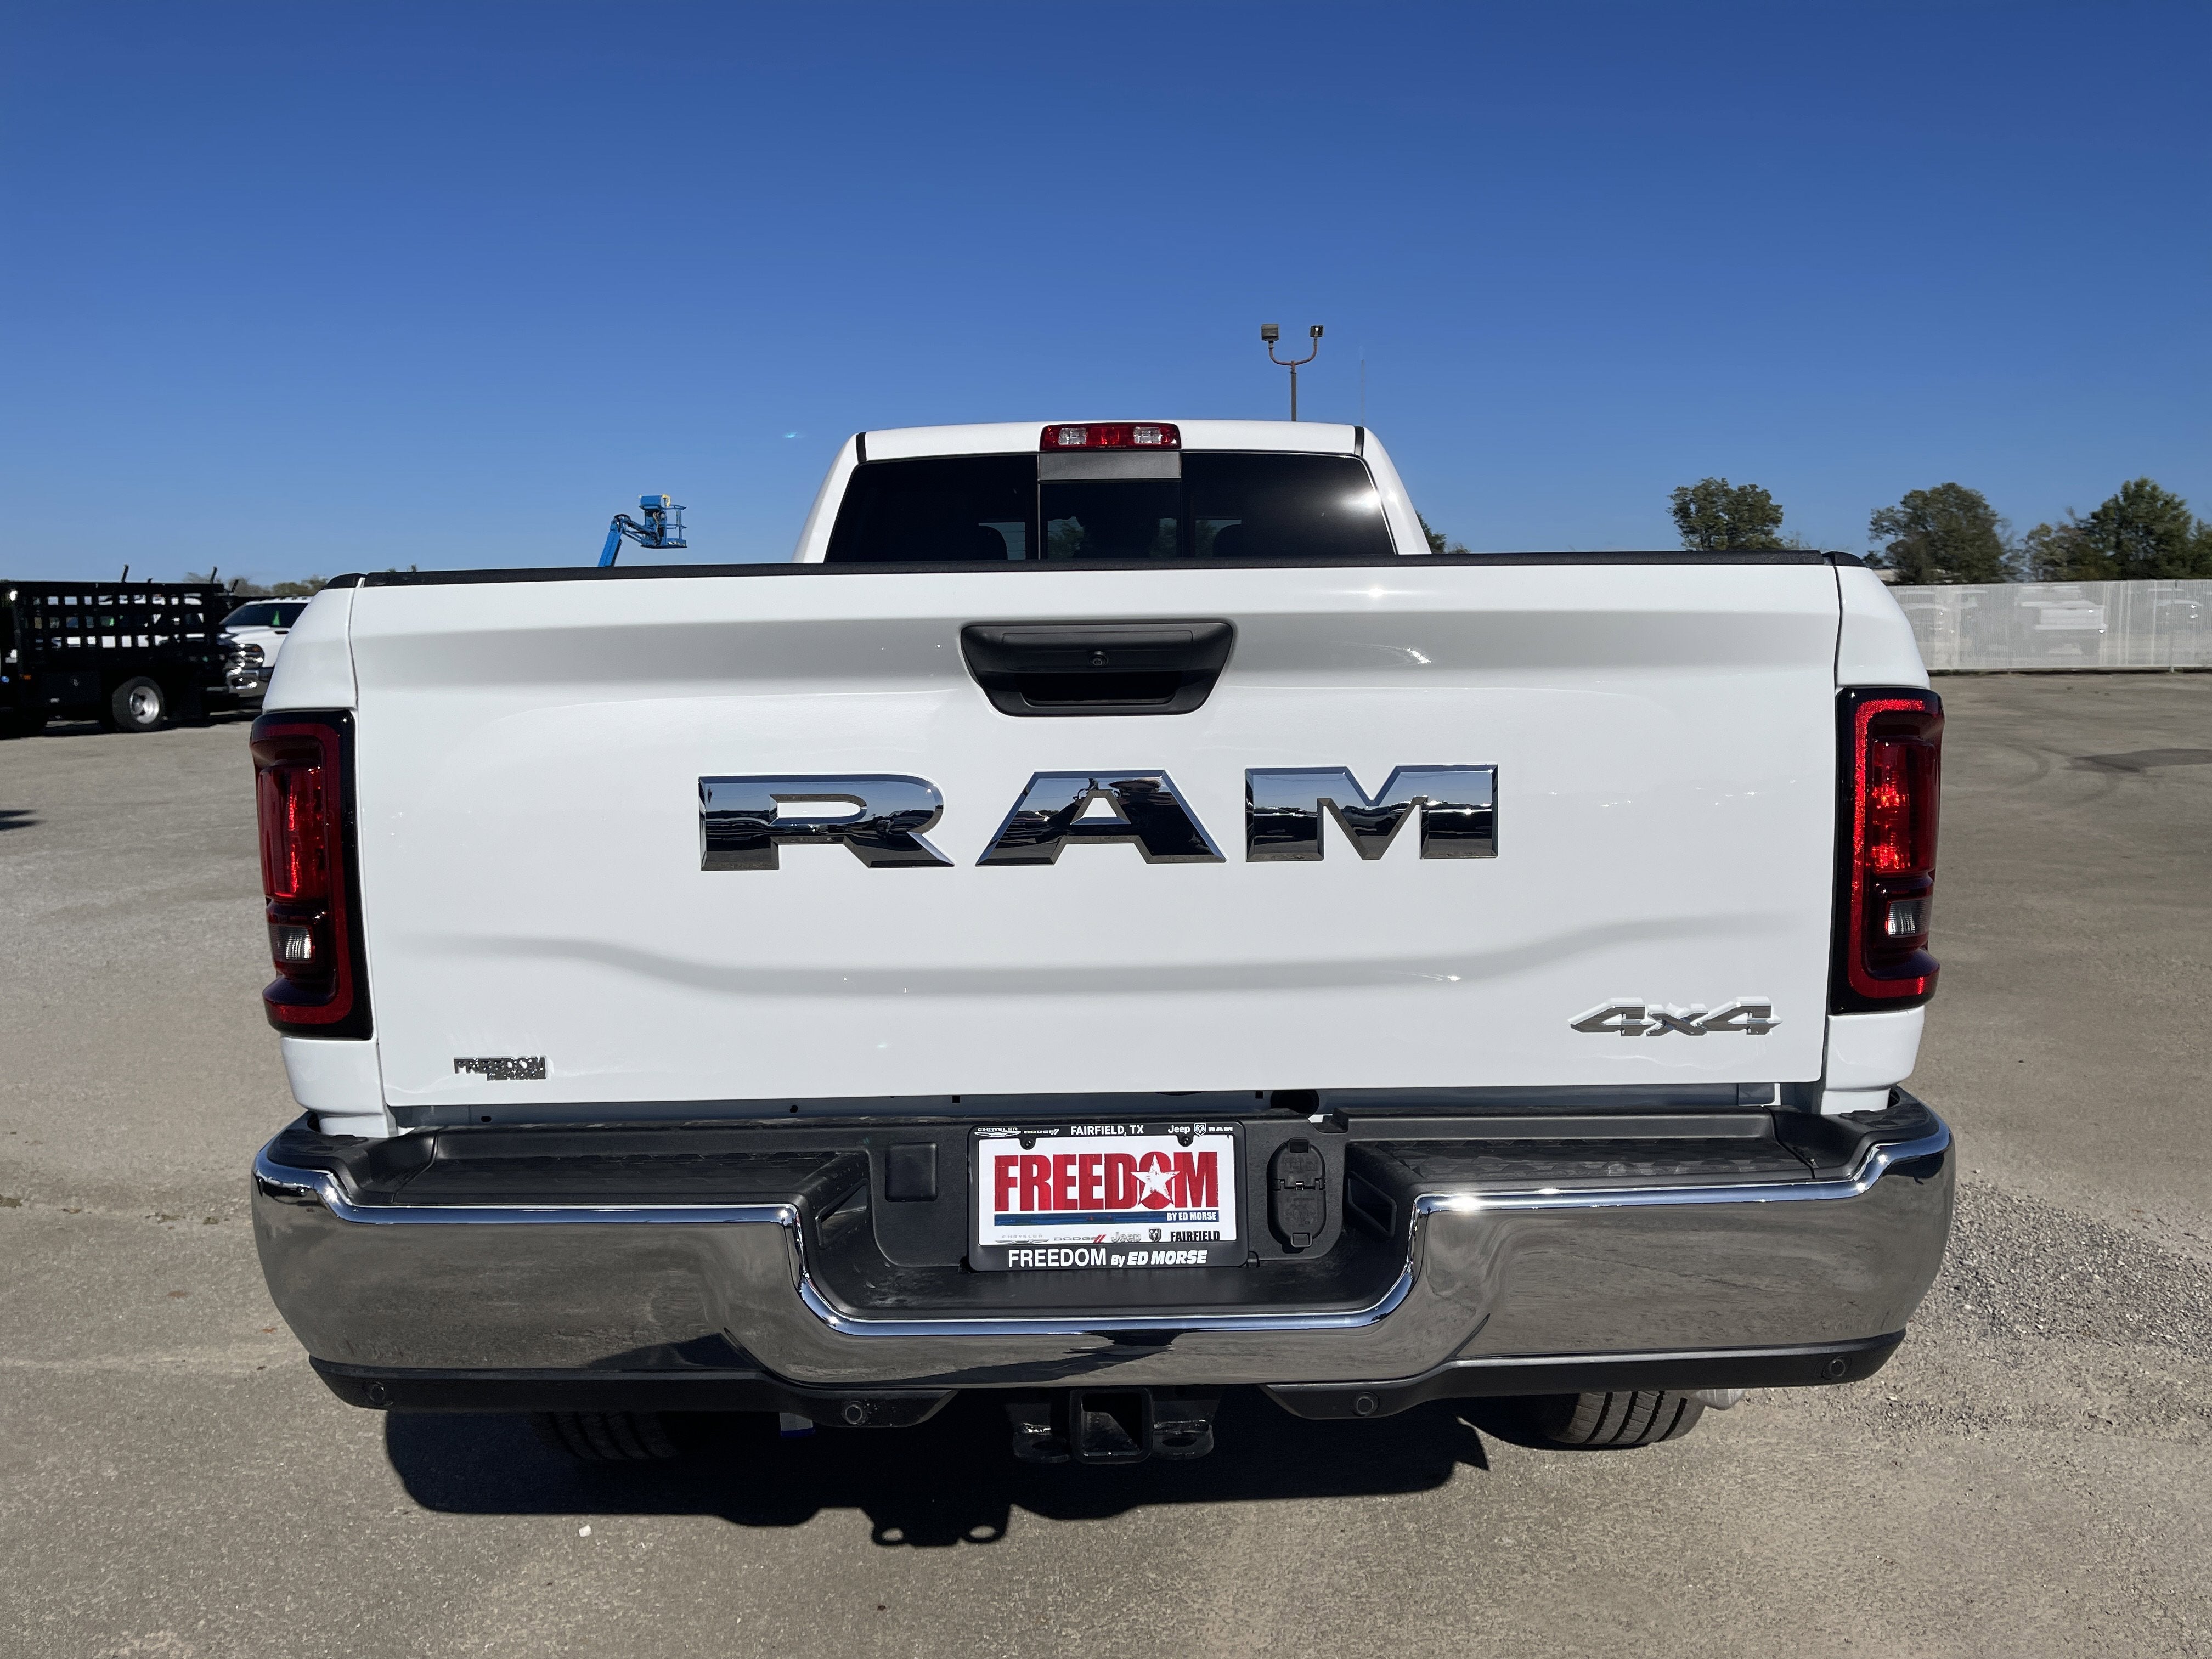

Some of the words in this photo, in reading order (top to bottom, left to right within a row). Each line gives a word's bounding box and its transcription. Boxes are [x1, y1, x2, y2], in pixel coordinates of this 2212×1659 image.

[699, 765, 1499, 871] RAM
[1070, 1125, 1127, 1136] FAIRFIELD,
[1129, 1125, 1144, 1135] TX
[1167, 1125, 1190, 1134] Jeep
[994, 1152, 1219, 1211] FREEDOM
[1167, 1212, 1177, 1221] BY
[1178, 1212, 1188, 1221] ED
[1189, 1211, 1217, 1220] MORSE
[1111, 1232, 1142, 1242] Jeep
[1170, 1231, 1220, 1242] FAIRFIELD
[1008, 1248, 1107, 1267] FREEDOM
[1110, 1255, 1126, 1266] By
[1127, 1251, 1149, 1265] ED
[1150, 1250, 1208, 1265] MORSE
